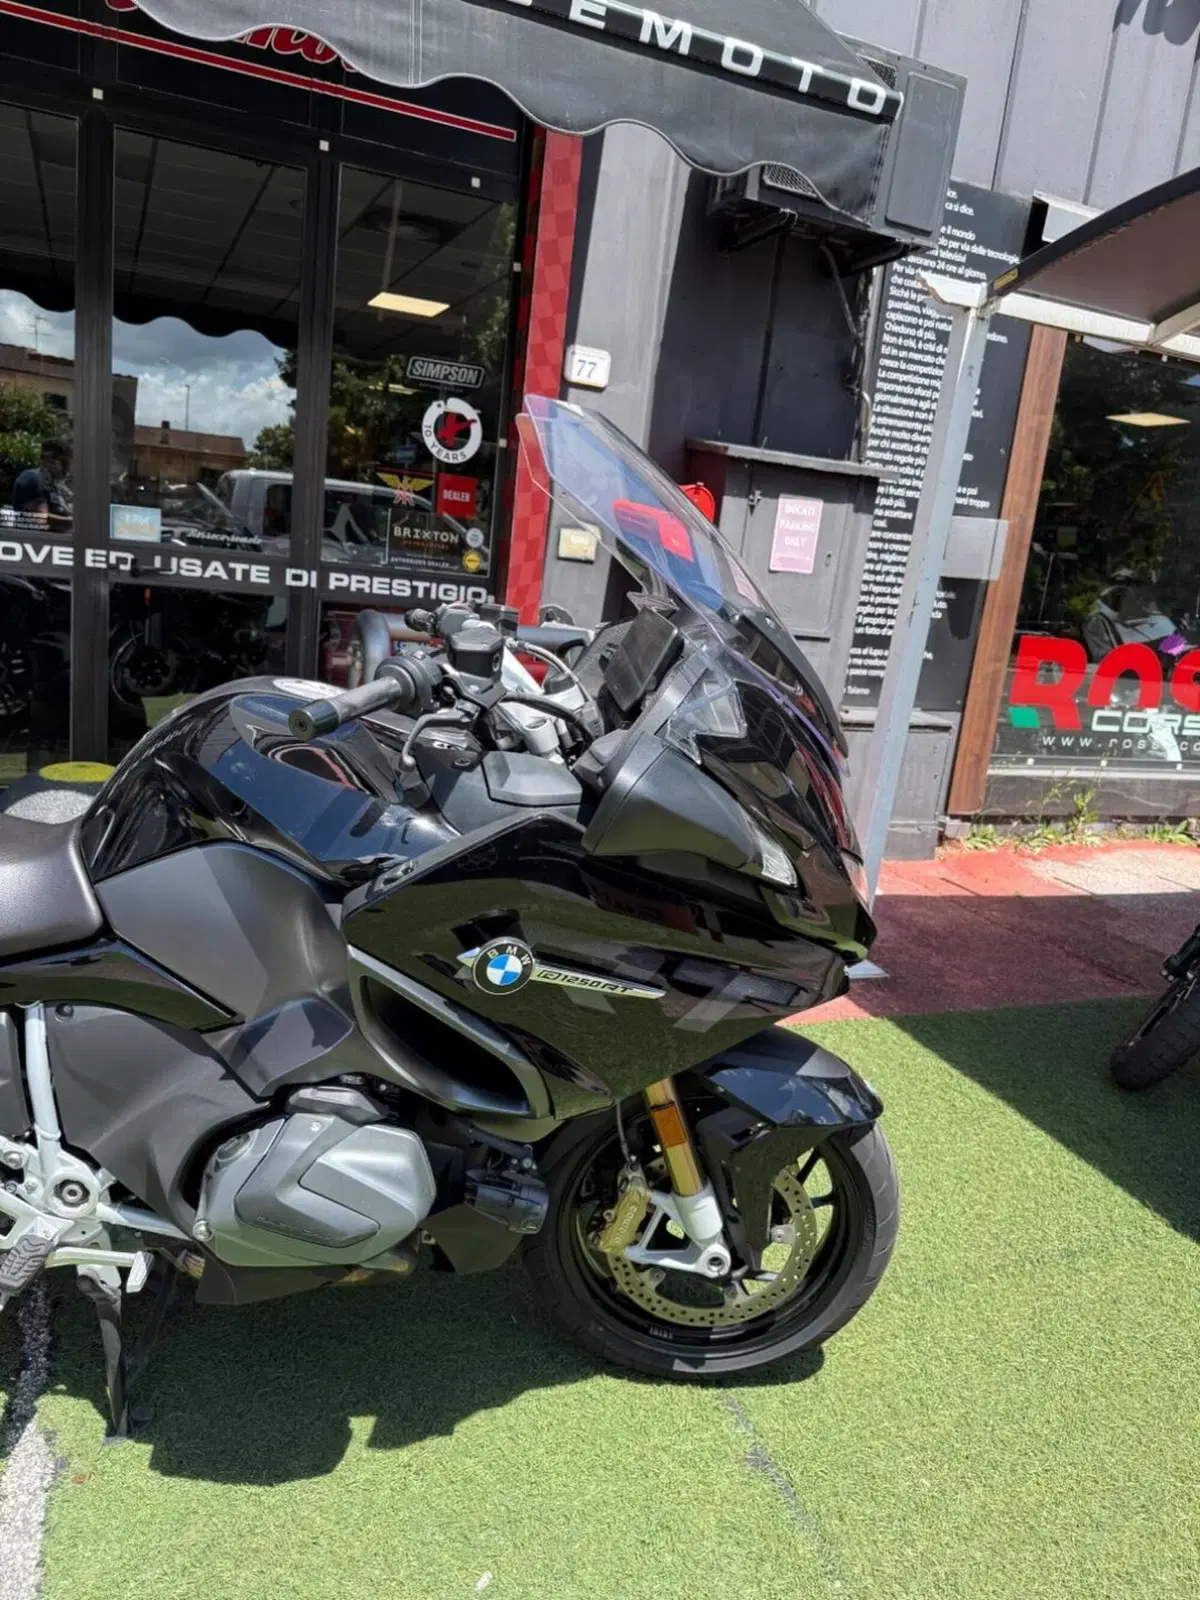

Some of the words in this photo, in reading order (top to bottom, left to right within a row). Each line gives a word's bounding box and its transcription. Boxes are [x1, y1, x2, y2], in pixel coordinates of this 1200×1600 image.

[503, 0, 886, 115] EMOTO
[952, 228, 976, 240] mondo
[948, 239, 959, 250] per
[892, 262, 905, 273] Per
[937, 260, 945, 270] 24
[890, 274, 903, 284] che
[884, 321, 916, 336] Chiedono
[923, 319, 935, 329] poi
[986, 332, 1008, 344] edono.
[882, 333, 897, 344] Non
[881, 345, 890, 355] Ed
[908, 352, 935, 364] mercato
[411, 361, 479, 386] SIMPSON
[576, 359, 597, 378] 77
[424, 423, 432, 438] 10
[431, 439, 467, 462] YEARS
[442, 489, 471, 503] DEALER
[393, 526, 459, 543] BRIXTON
[154, 555, 271, 585] USATE
[285, 567, 318, 588] DI
[1041, 735, 1200, 751] www.rossco
[486, 944, 531, 966] BMW
[536, 968, 633, 993] R1250RT
[611, 1204, 638, 1244] brembo
